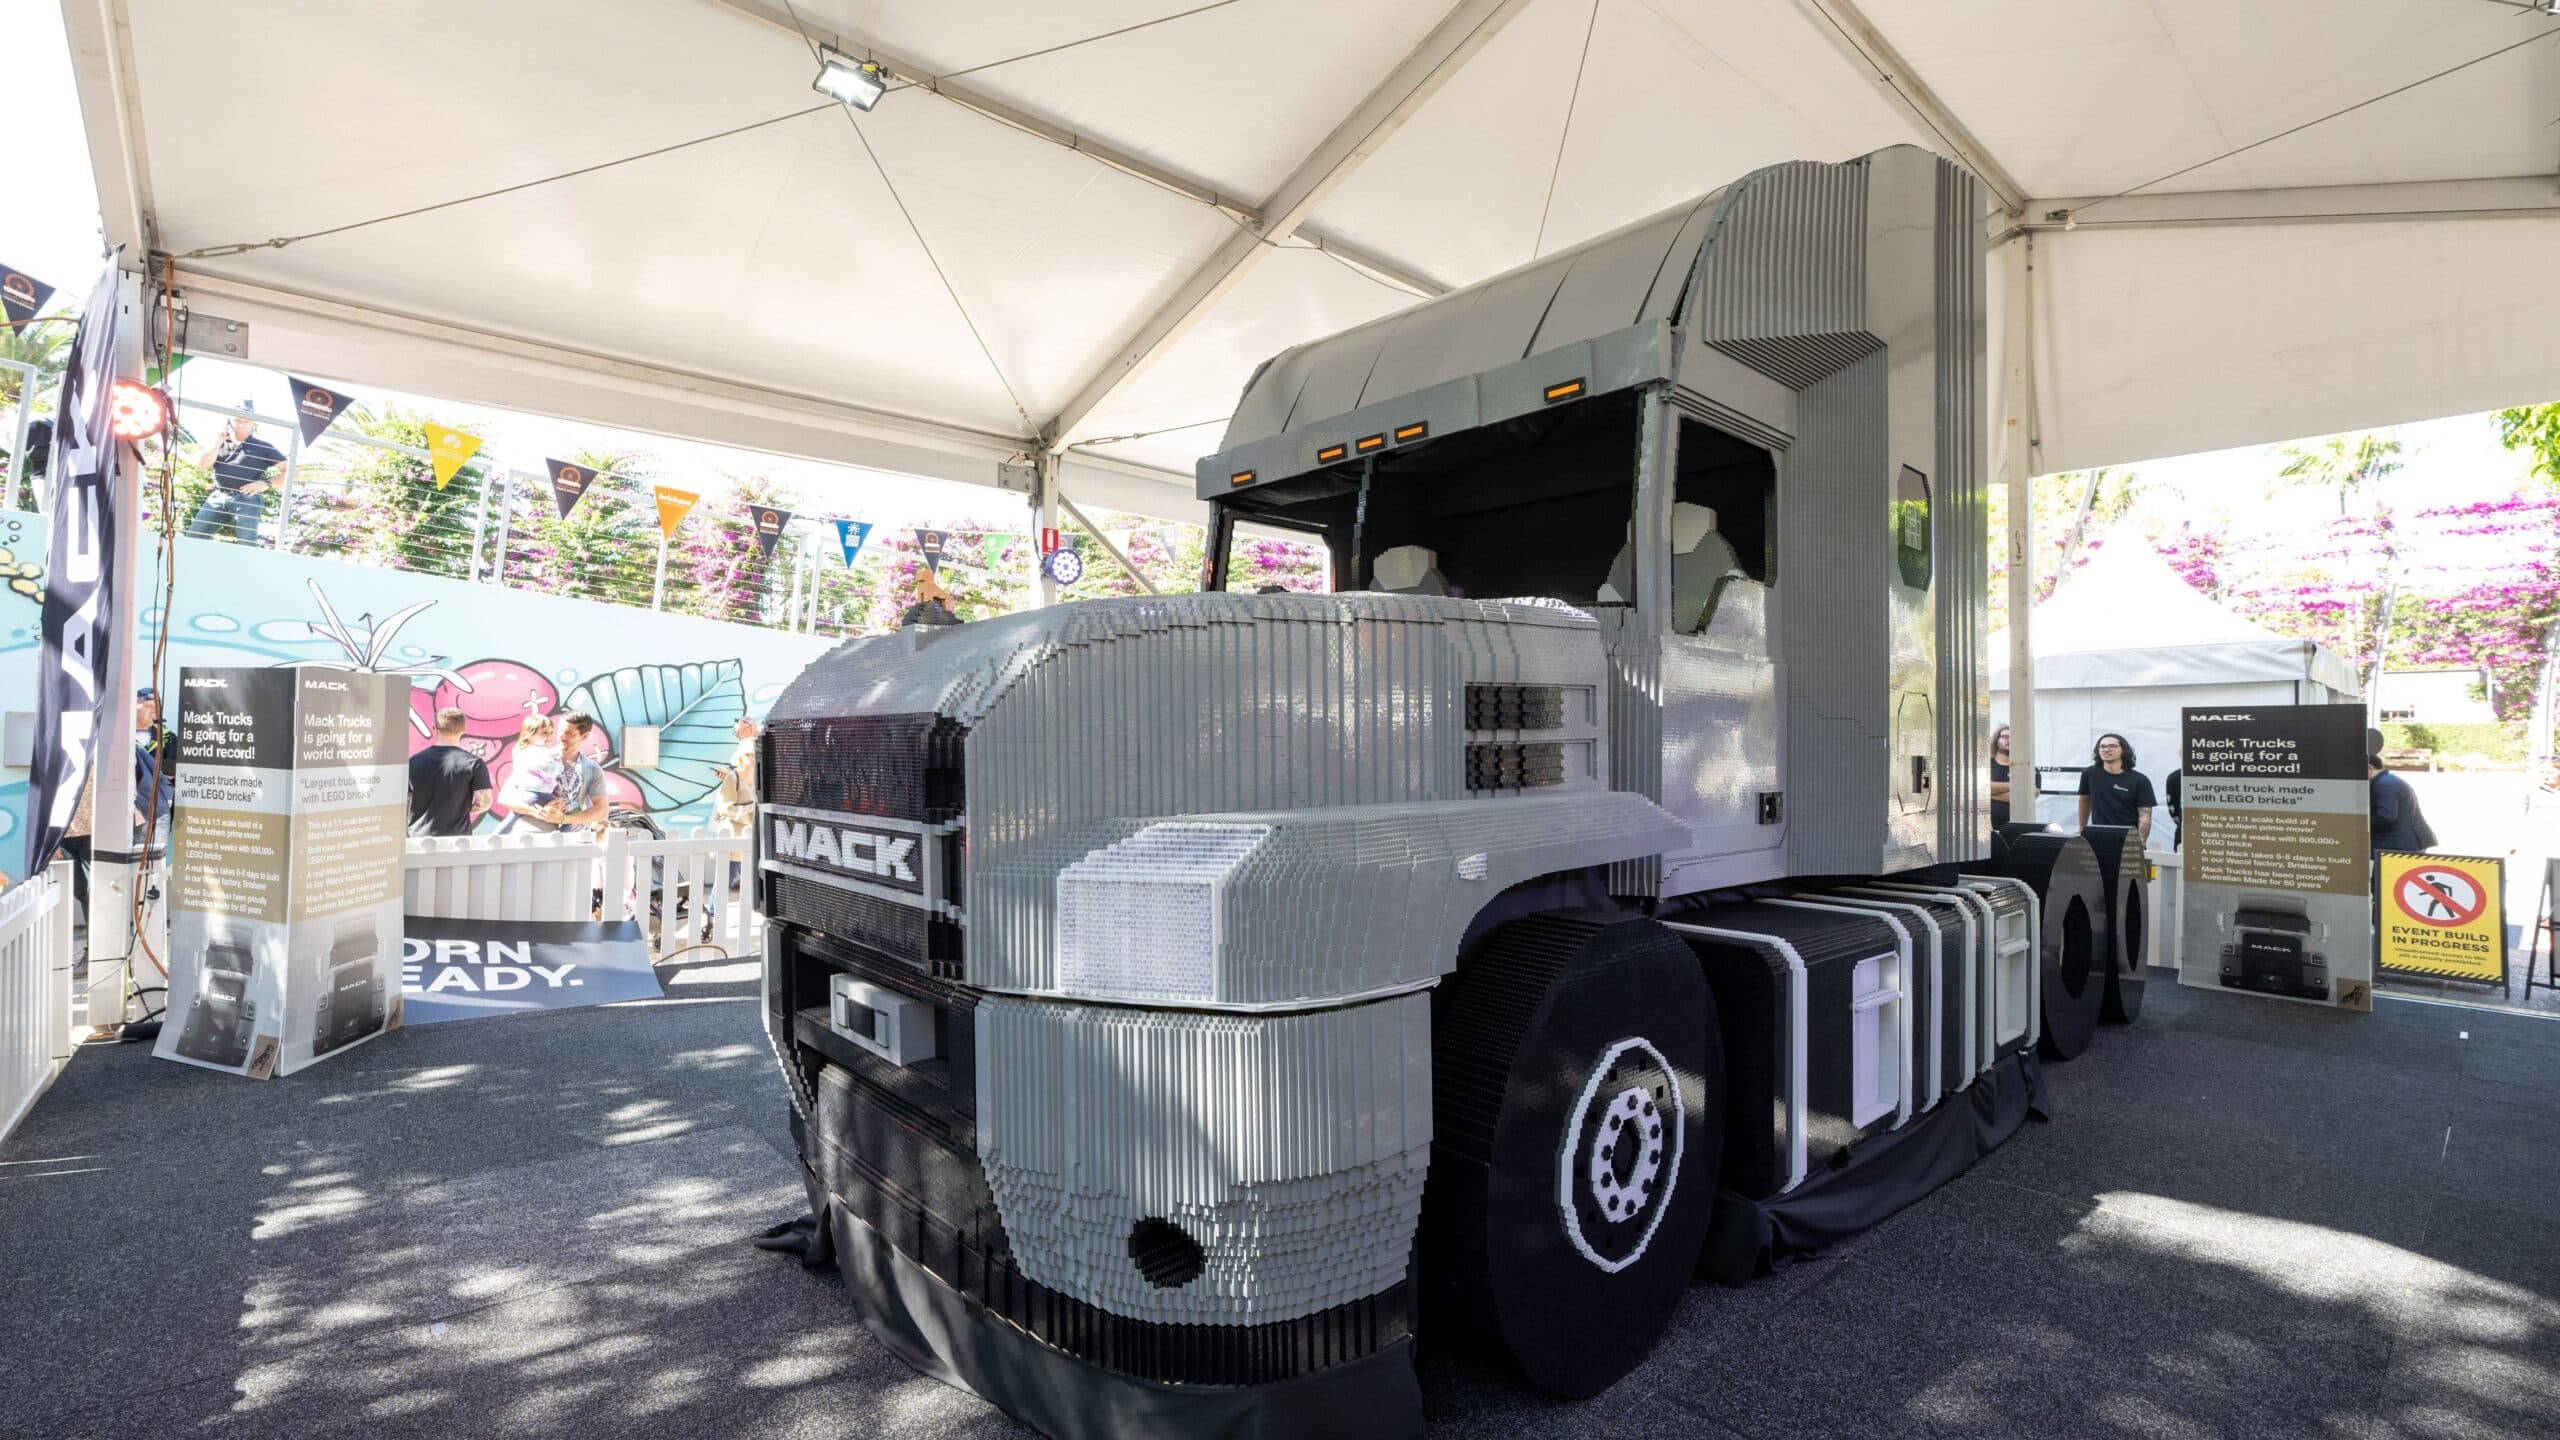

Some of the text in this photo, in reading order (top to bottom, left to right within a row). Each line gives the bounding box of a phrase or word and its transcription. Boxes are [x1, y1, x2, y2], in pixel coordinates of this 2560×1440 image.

[183, 710, 253, 726] Mack Trucks
[304, 714, 372, 728] Mack Trucks
[183, 727, 254, 744] is going for a
[303, 730, 372, 747] is going for a
[2191, 738, 2296, 748] Mack Trucks
[182, 744, 256, 760] world record!
[303, 746, 373, 760] world record!
[2191, 750, 2298, 762] is going for a
[2191, 762, 2301, 773] world record!
[180, 773, 263, 788] “Largest truck made
[181, 788, 256, 802] with LEGO bricks”
[2189, 783, 2314, 795] “Largest truck made
[2191, 793, 2303, 805] with LEGO bricks”
[2275, 817, 2297, 825] build
[774, 819, 917, 882] MACK
[2227, 840, 2252, 848] bricks
[2253, 860, 2285, 869] factory,
[2287, 862, 2328, 871] Brisbane
[2292, 855, 2314, 863] days
[2328, 857, 2352, 865] build
[2201, 873, 2241, 882] Australian
[2243, 876, 2268, 884] Made
[2269, 878, 2282, 886] for
[2297, 881, 2321, 889] years
[2226, 867, 2252, 875] Trucks
[2254, 869, 2270, 877] has
[2272, 871, 2294, 879] been
[2296, 873, 2330, 883] proudly
[2392, 925, 2490, 942] EVENT BUILD
[2392, 935, 2490, 953] IN PROGRESS
